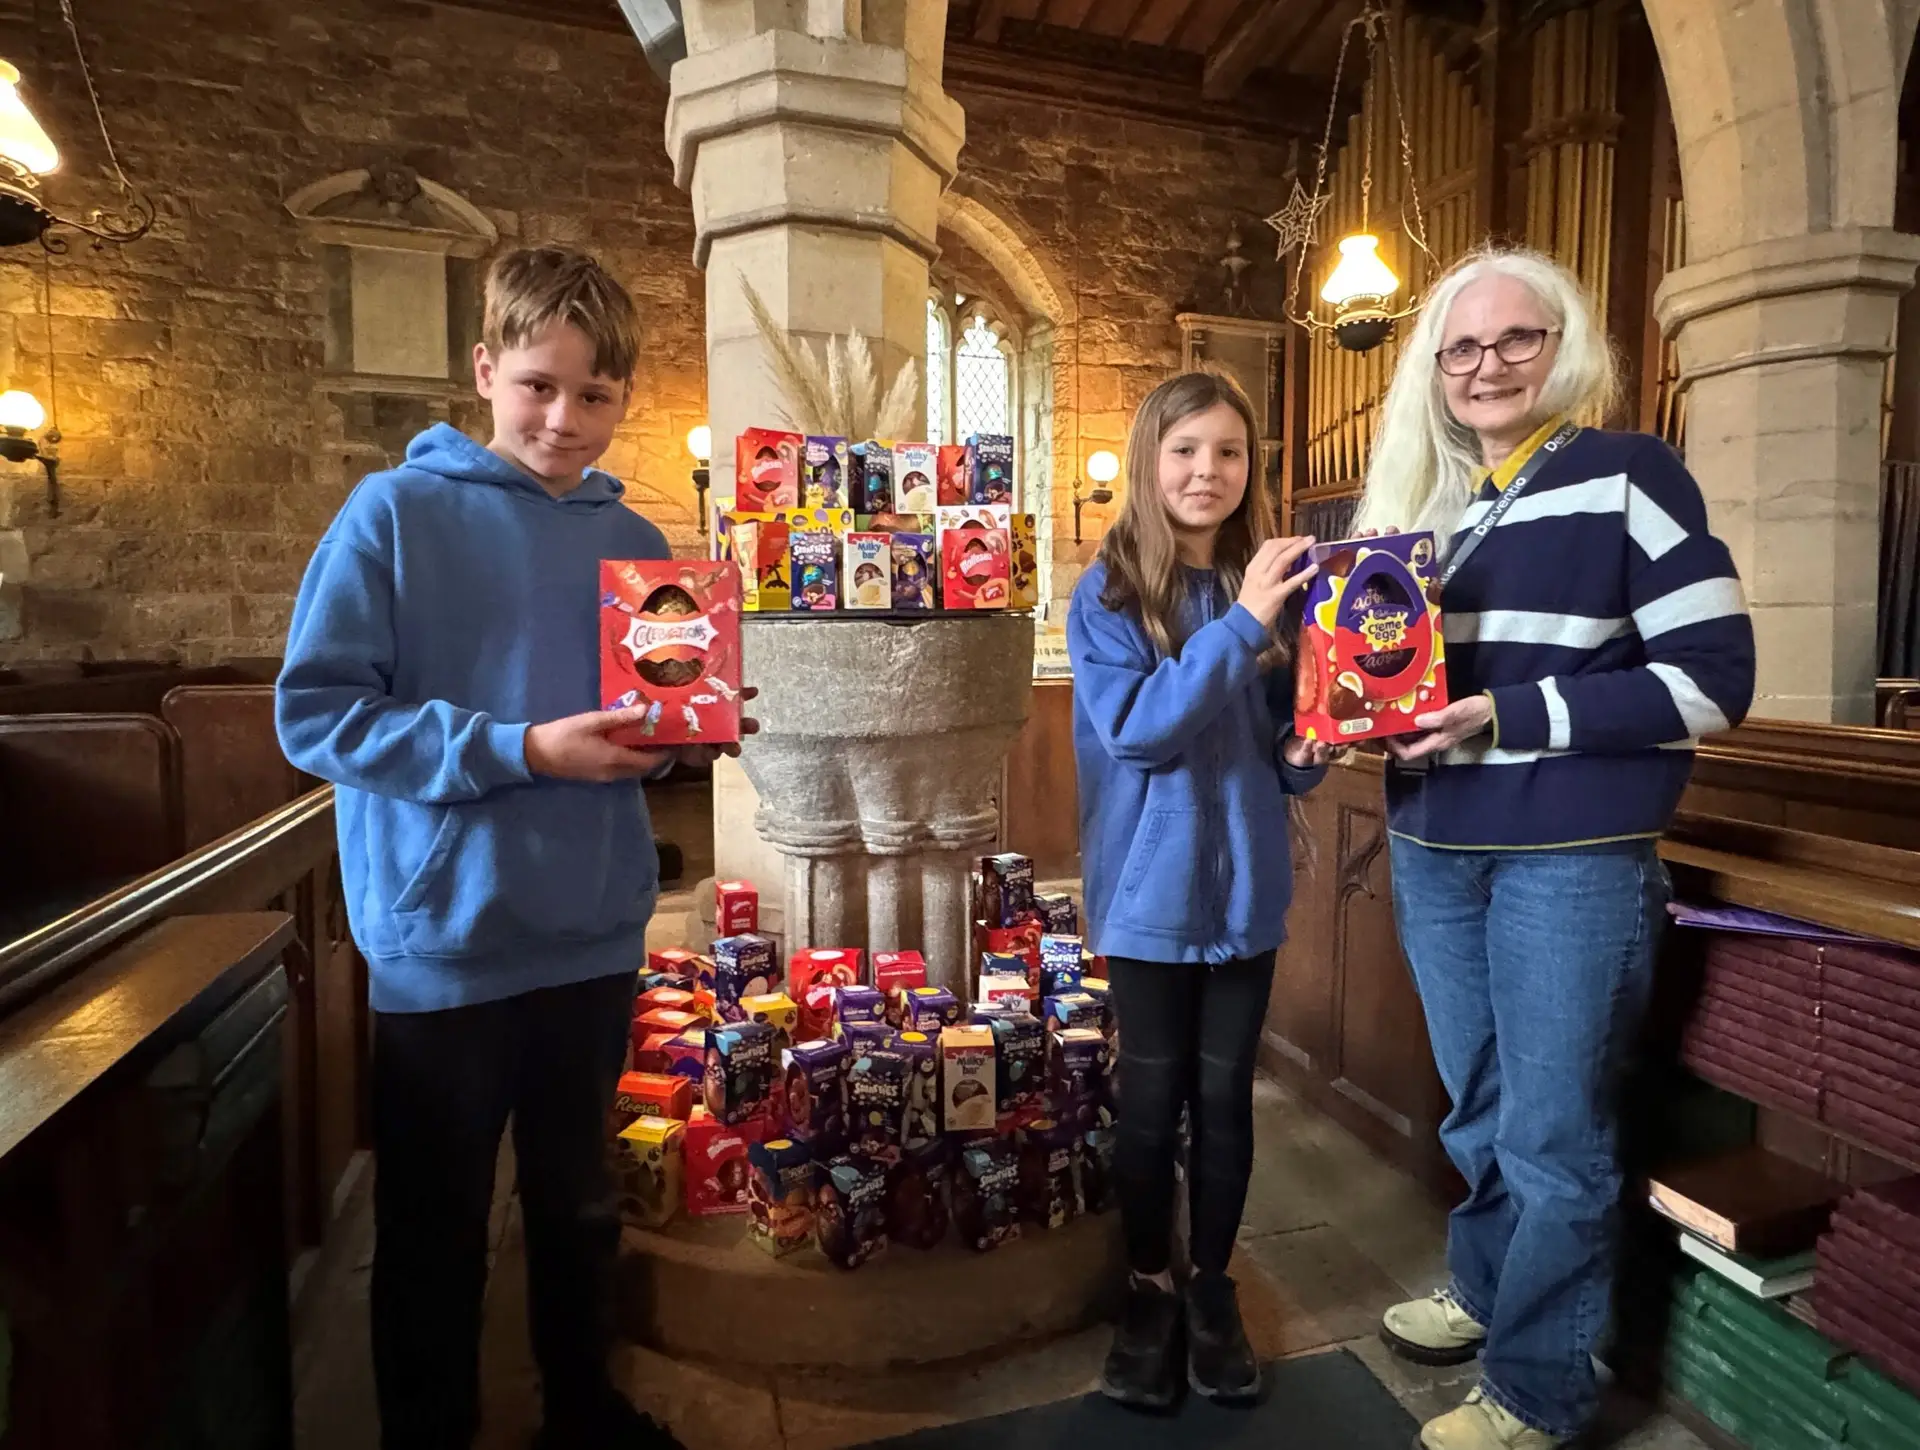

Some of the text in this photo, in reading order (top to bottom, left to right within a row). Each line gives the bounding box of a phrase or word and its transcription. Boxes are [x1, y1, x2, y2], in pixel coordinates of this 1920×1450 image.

[1473, 477, 1527, 536] Derventio
[857, 542, 881, 552] Milky
[862, 551, 876, 559] bar
[1368, 621, 1402, 634] Creme
[1375, 630, 1397, 642] egg
